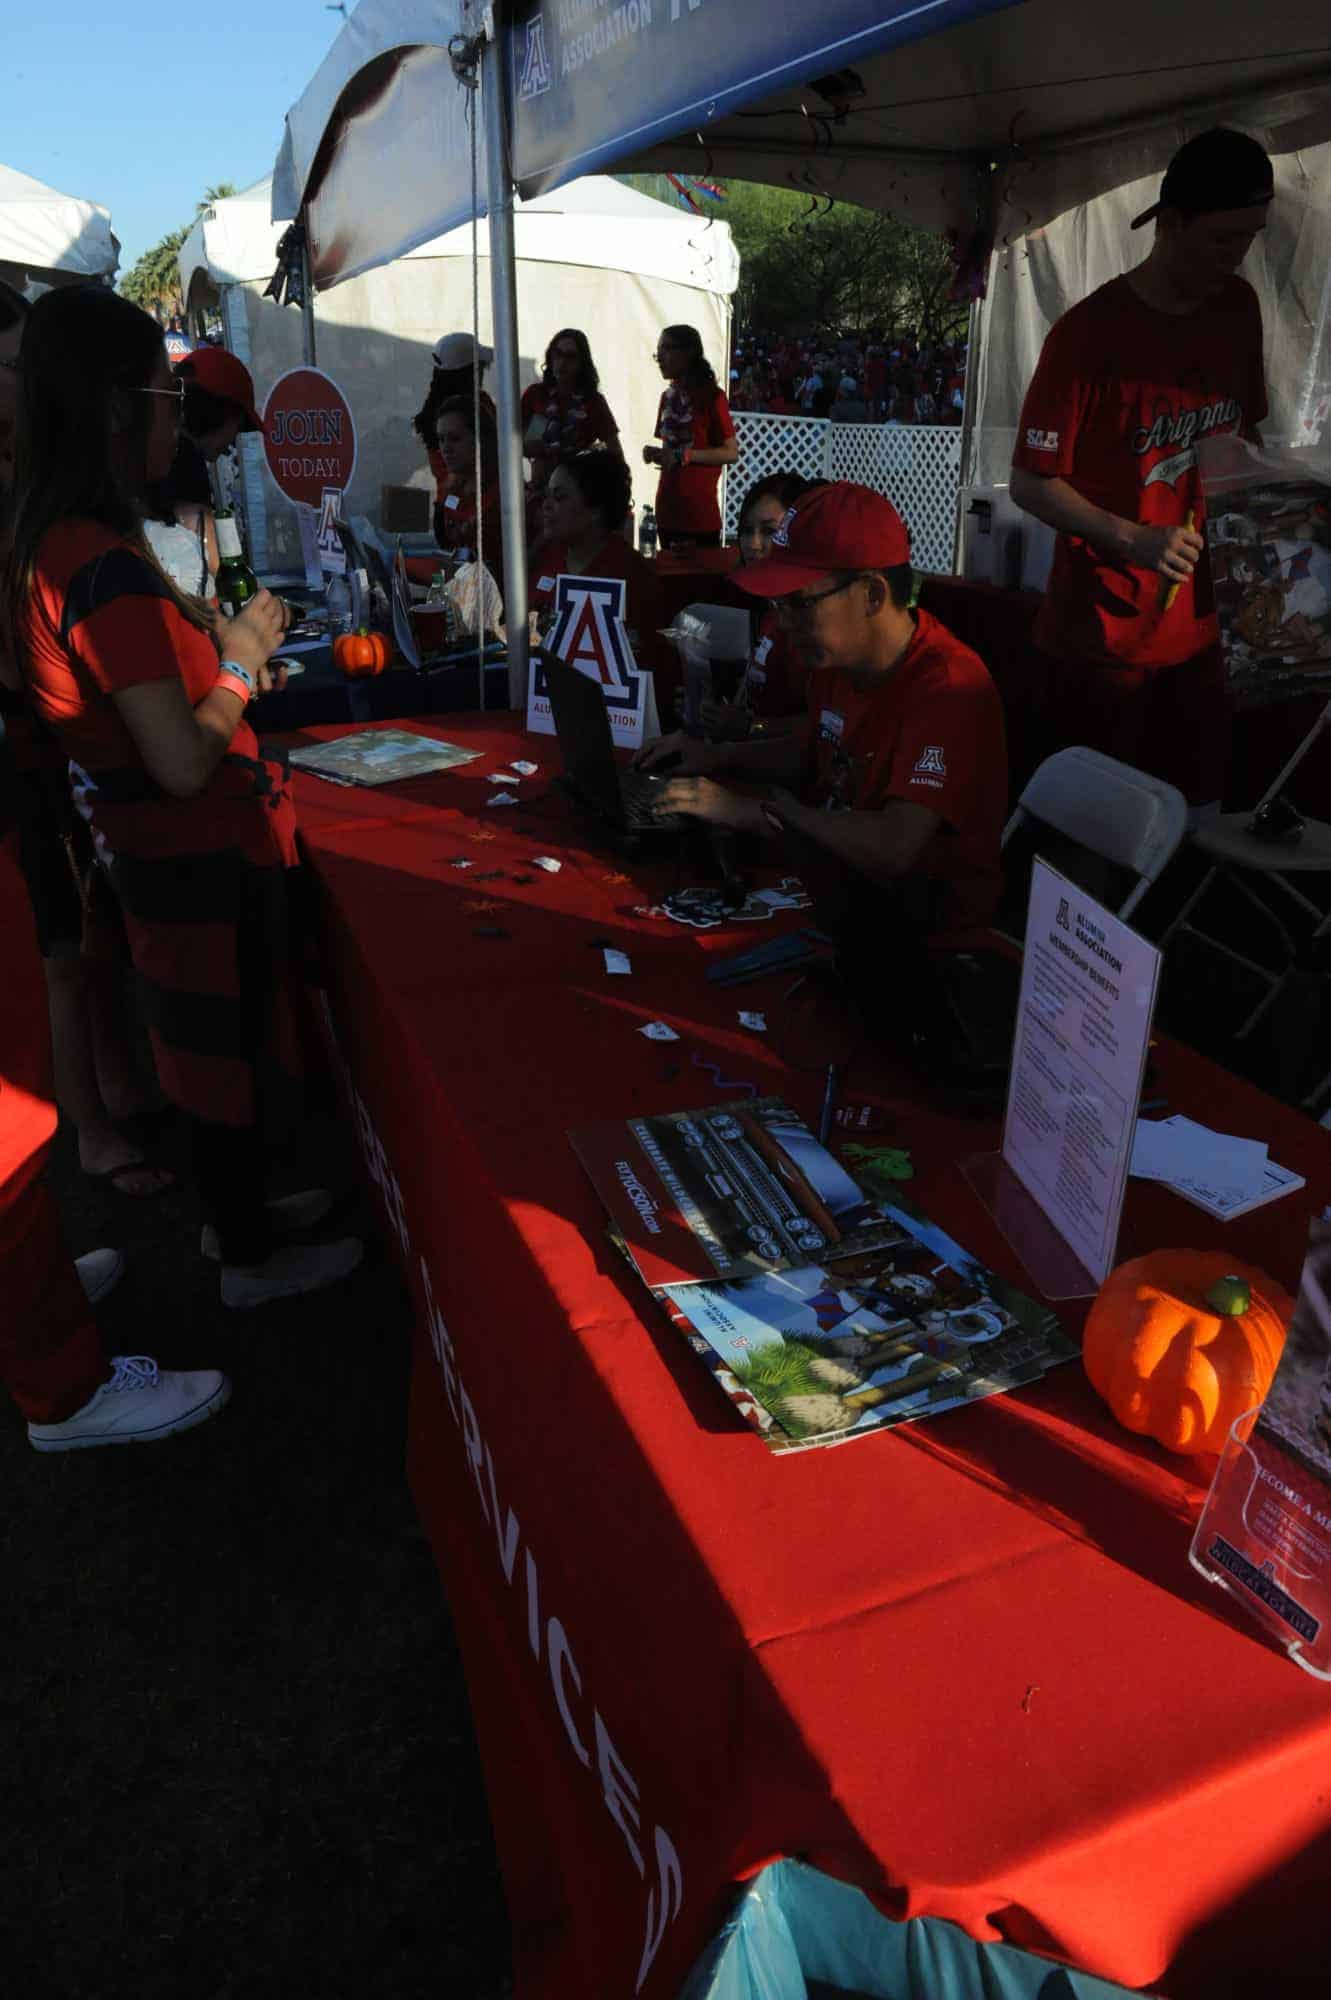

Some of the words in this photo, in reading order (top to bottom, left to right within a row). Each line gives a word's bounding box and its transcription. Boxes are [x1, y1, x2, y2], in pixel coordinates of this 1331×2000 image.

[561, 0, 651, 77] ASSOCIATION
[271, 409, 344, 446] JOIN
[1136, 399, 1241, 455] Arizona
[278, 456, 342, 478] TODAY!
[534, 573, 640, 710] A
[912, 745, 947, 776] A
[1076, 928, 1122, 974] ASSOCIATION
[418, 1254, 685, 1998] SERVICES
